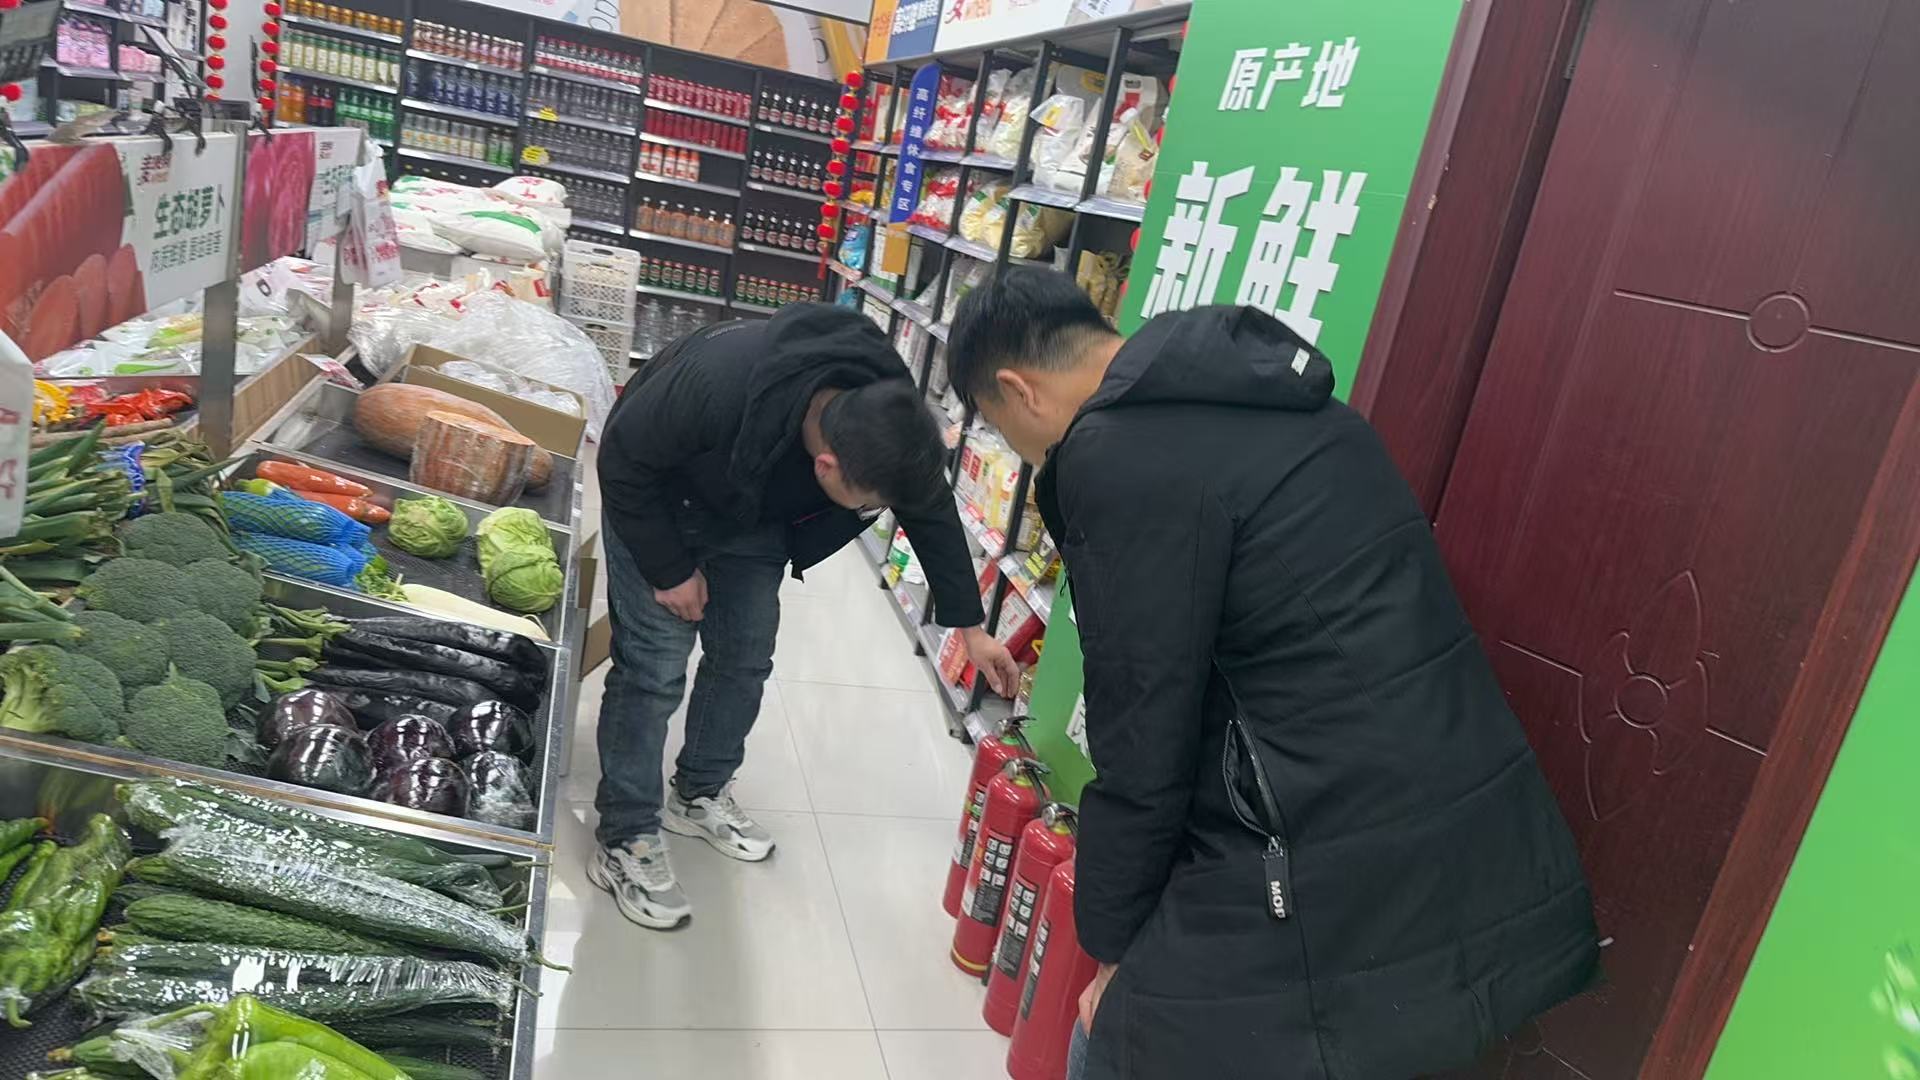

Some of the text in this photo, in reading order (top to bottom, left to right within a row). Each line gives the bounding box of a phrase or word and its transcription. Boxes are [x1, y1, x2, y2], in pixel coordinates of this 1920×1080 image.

[1217, 36, 1361, 111] 原产地
[1140, 160, 1368, 346] 新鲜
